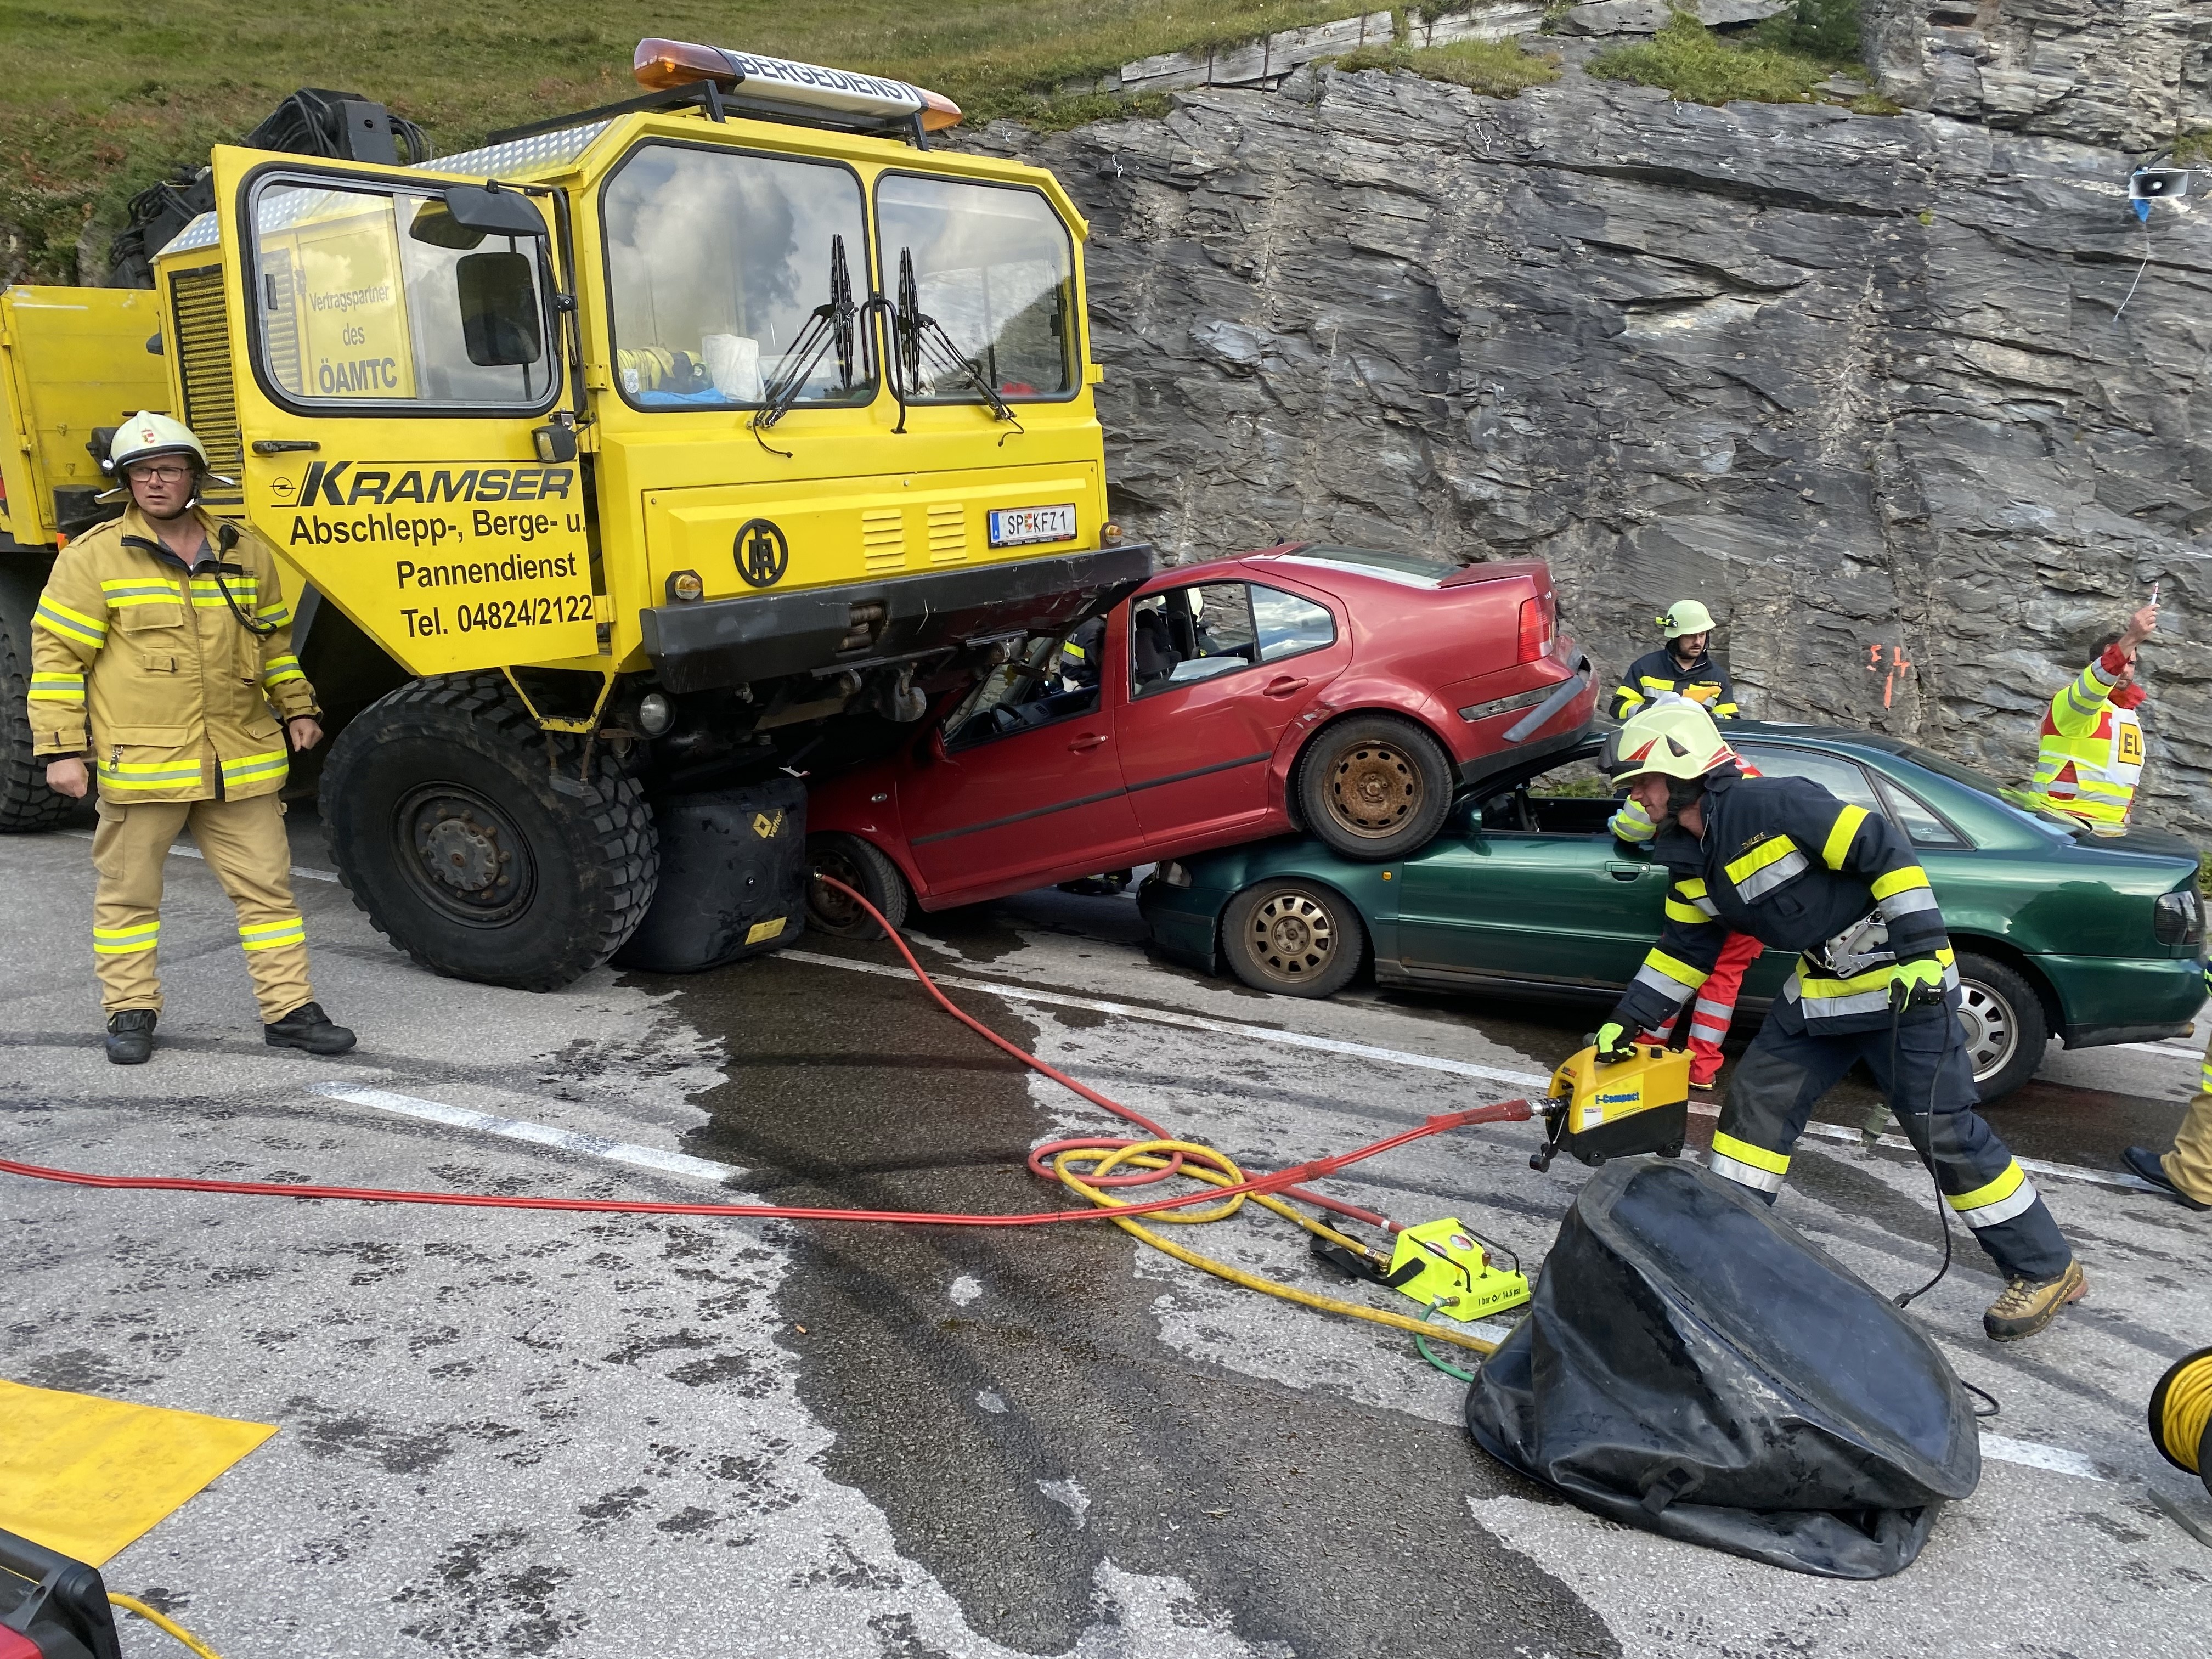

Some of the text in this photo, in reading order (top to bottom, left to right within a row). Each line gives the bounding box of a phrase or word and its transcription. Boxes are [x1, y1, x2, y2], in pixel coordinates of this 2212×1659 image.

[735, 55, 915, 101] BERGEDIENST
[309, 285, 390, 312] Vertragspartner
[343, 323, 365, 346] des
[319, 357, 397, 394] ÖAMTC
[299, 461, 574, 506] KRAMSER
[290, 509, 585, 546] Abschlepp-, Berge- u.
[1008, 515, 1023, 535] SP
[396, 551, 577, 589] Pannendienst
[400, 594, 594, 638] Tel. 04824/2122
[2124, 733, 2140, 755] EL
[769, 811, 782, 837] vetter
[1595, 1092, 1639, 1104] E-Compact
[1482, 1297, 1490, 1305] bar
[1503, 1289, 1513, 1299] 14.5
